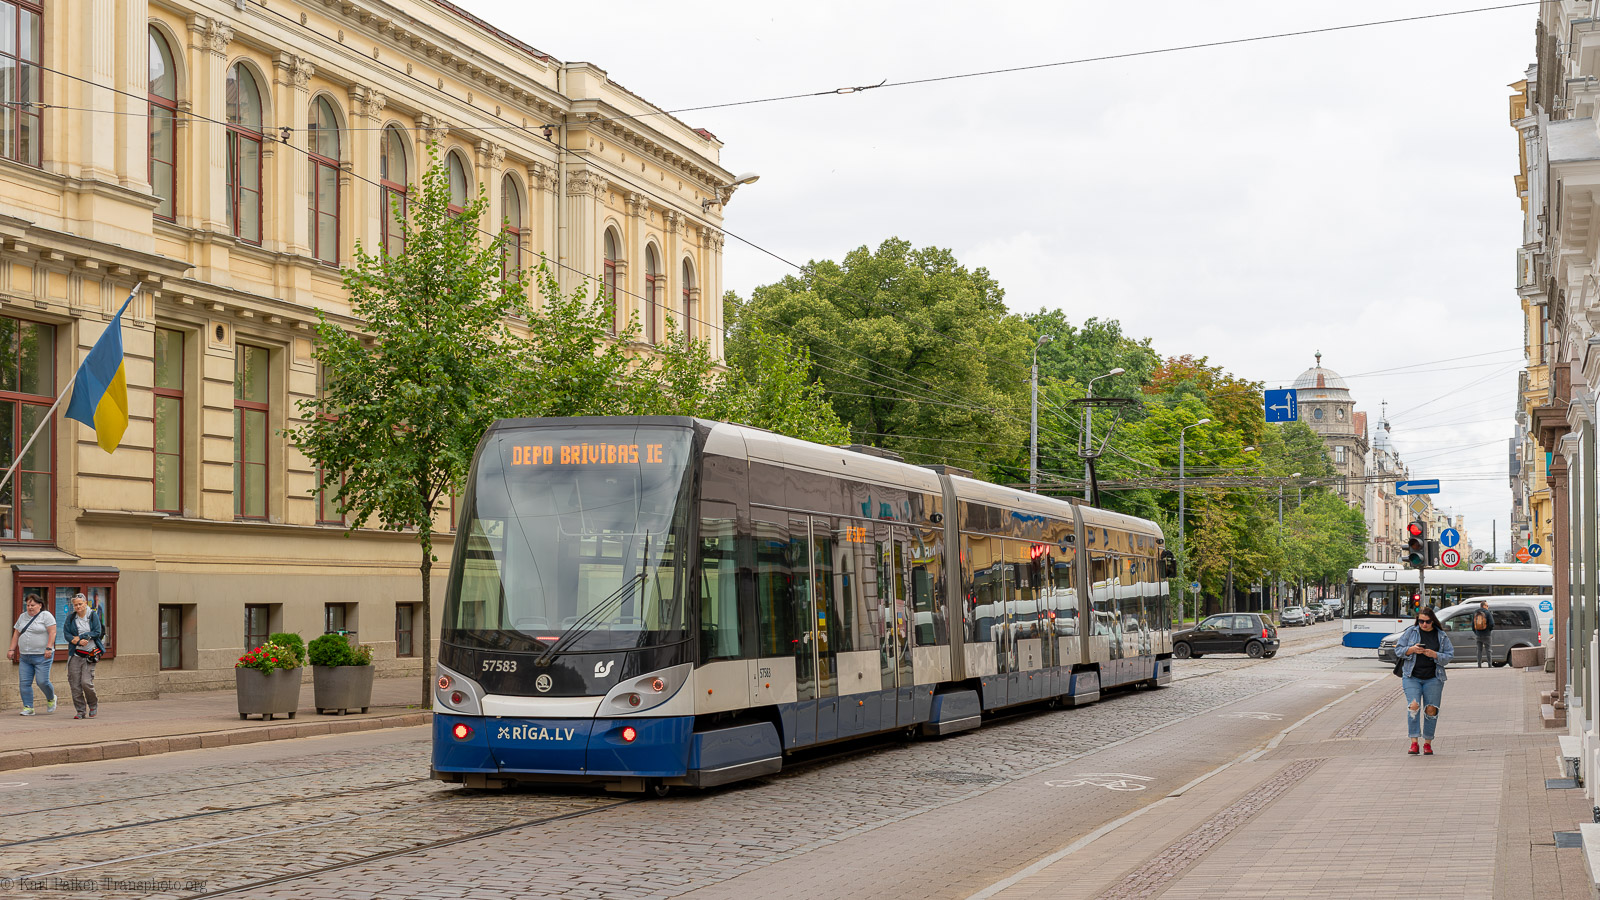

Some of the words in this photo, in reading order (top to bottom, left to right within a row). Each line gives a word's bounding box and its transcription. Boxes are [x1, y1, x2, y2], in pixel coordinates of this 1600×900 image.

[512, 446, 554, 465] DEPO
[560, 443, 639, 465] BRĪVĪBAS
[646, 444, 663, 464] IE
[1445, 553, 1456, 563] 30
[1474, 551, 1483, 560] 30
[482, 659, 518, 673] 57583
[759, 667, 772, 679] 57583
[512, 724, 575, 741] RĪGA.LV
